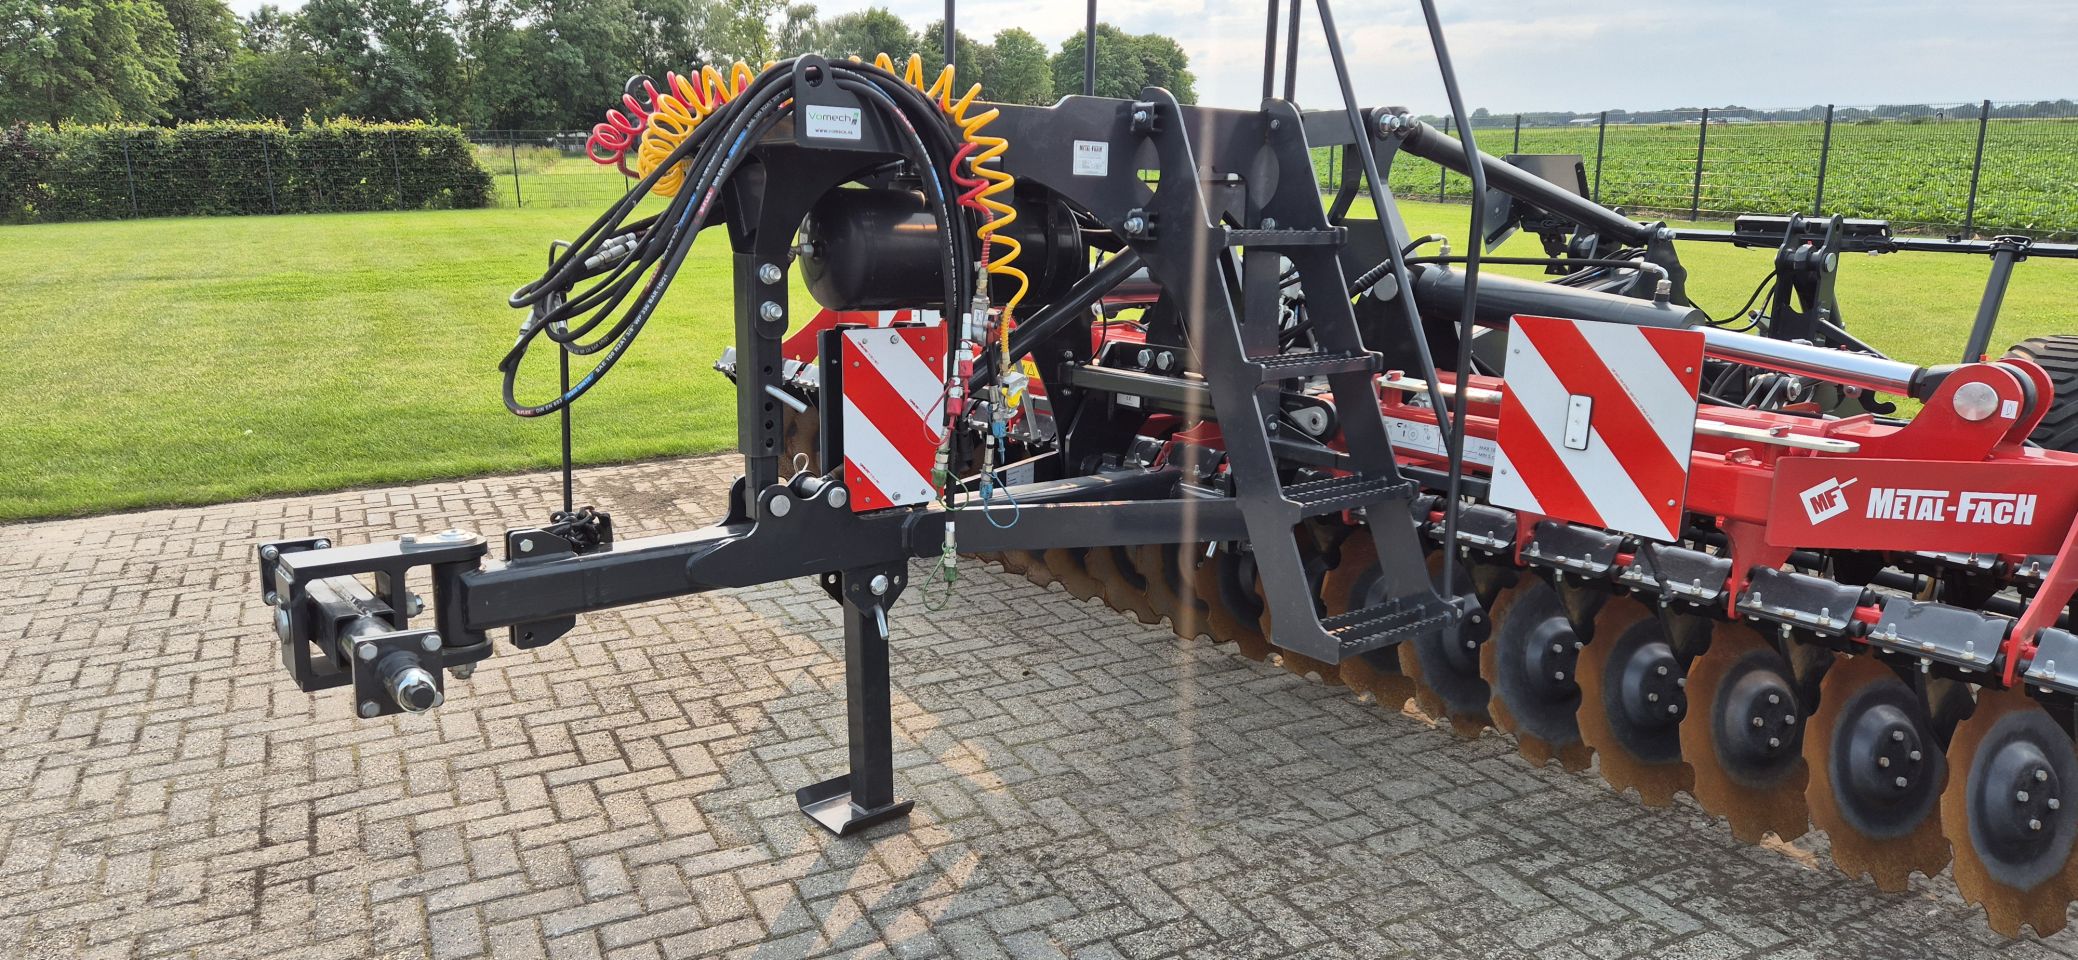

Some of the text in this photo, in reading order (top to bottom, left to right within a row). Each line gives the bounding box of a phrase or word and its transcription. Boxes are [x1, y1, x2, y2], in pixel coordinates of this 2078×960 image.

[595, 361, 607, 373] SAE
[1809, 489, 1839, 515] MF
[1866, 487, 2037, 526] METAL-FACH
